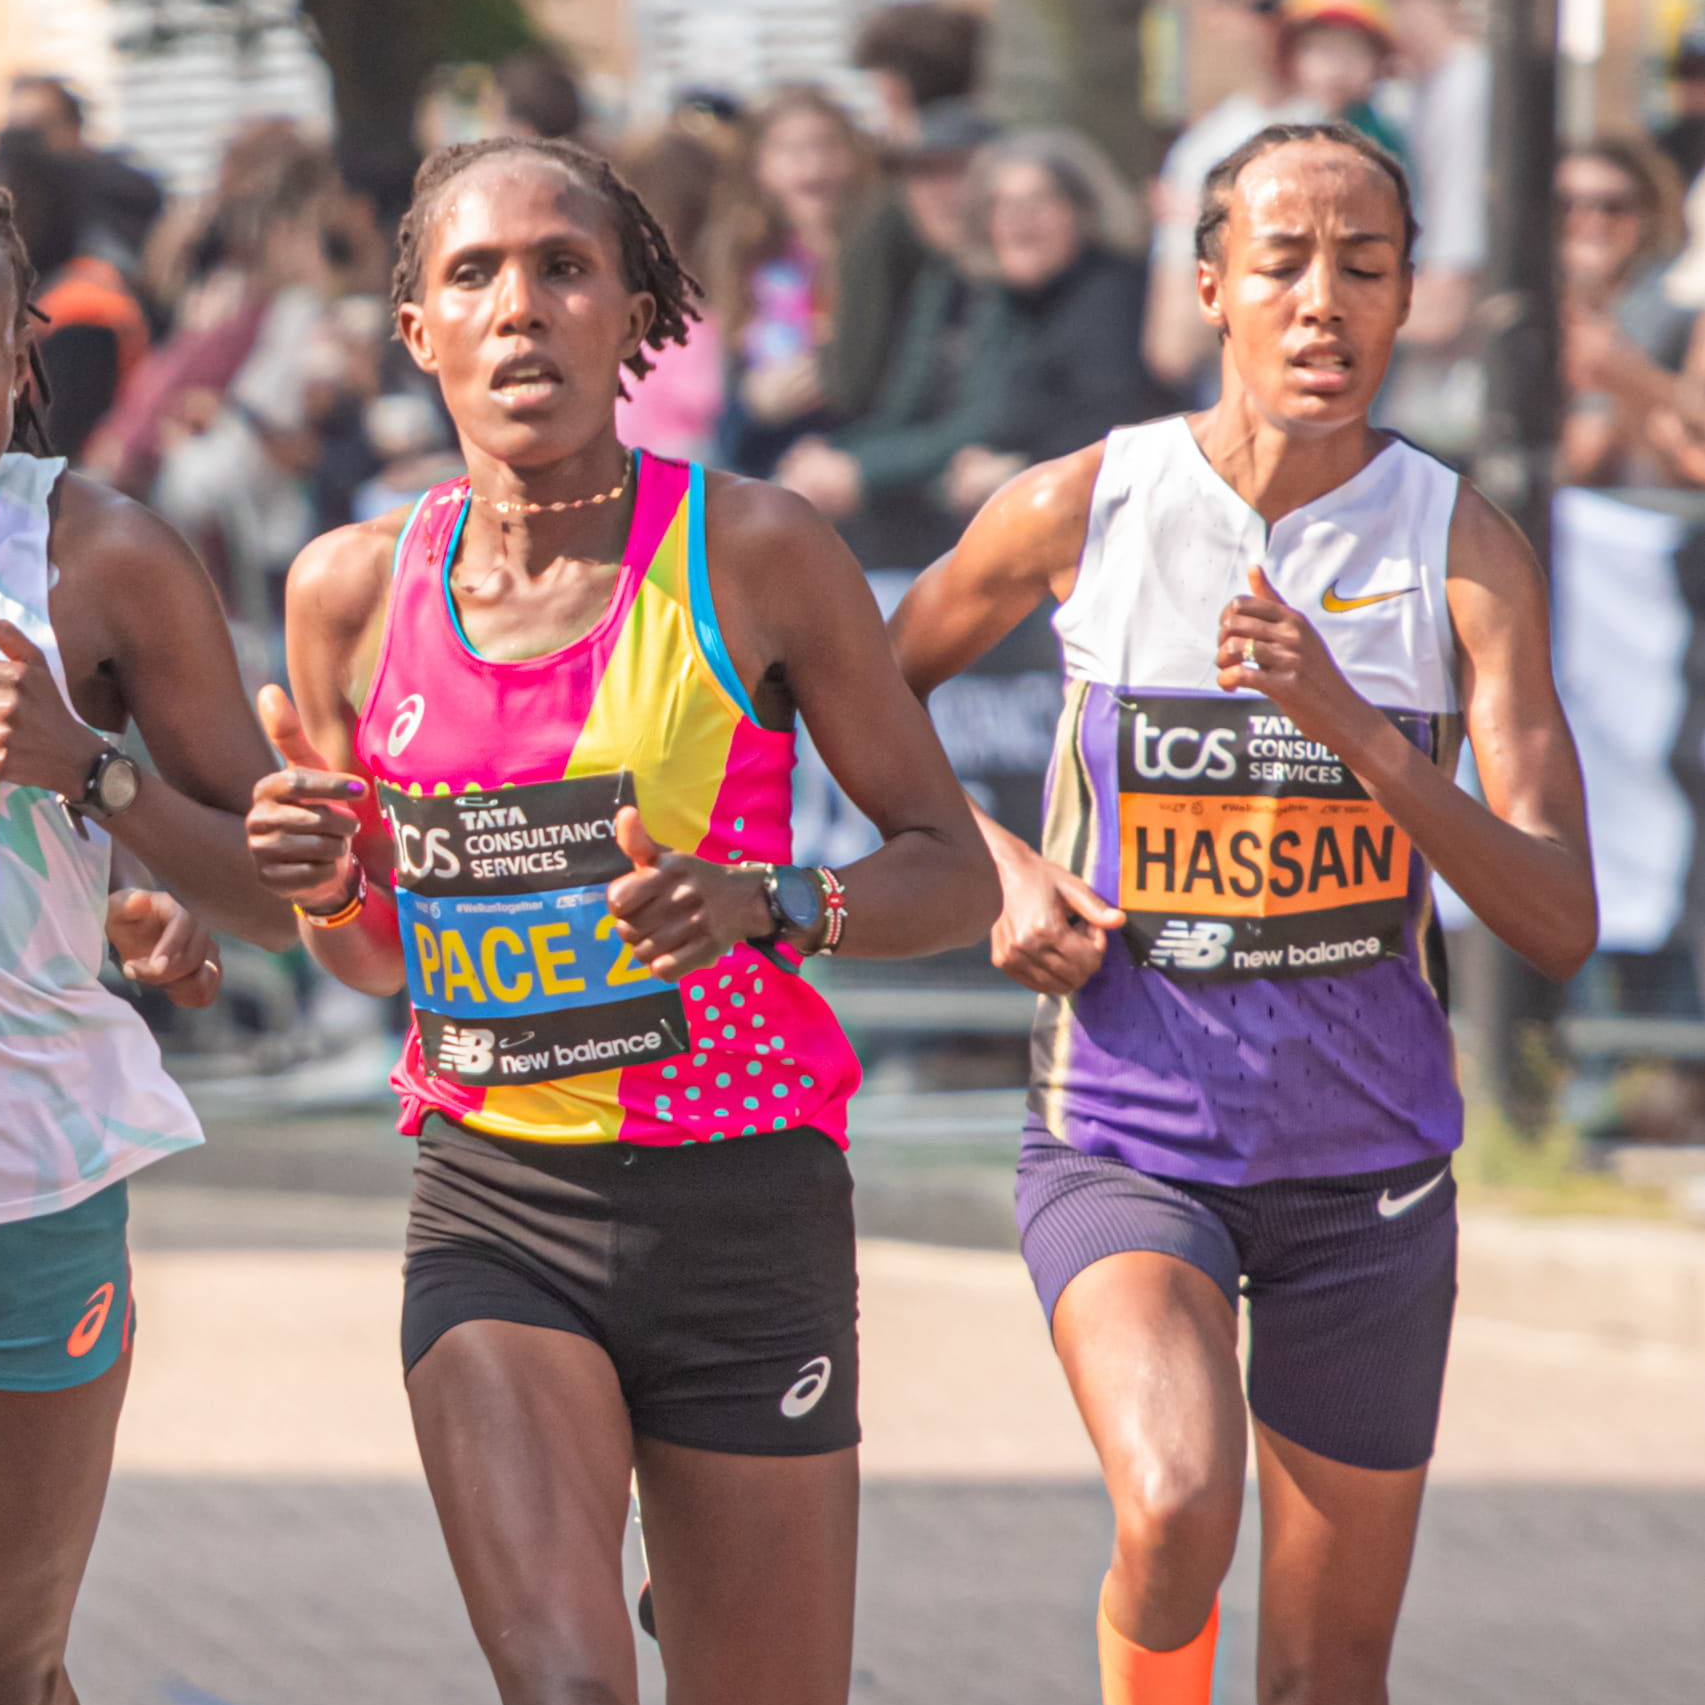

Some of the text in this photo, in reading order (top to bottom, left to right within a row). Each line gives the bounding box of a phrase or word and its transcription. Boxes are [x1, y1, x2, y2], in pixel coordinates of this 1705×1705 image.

[1248, 714, 1303, 736] TAT
[1134, 712, 1237, 780] tcs
[1247, 738, 1340, 763] CONSUL
[1248, 762, 1343, 785] SERVICES
[459, 806, 527, 831] TATA
[389, 804, 461, 878] tcs
[464, 818, 617, 855] CONSULTANCY
[470, 849, 567, 879] SERVICES
[1135, 825, 1395, 898] HASSAN
[413, 913, 652, 1003] PACE 2
[1233, 936, 1381, 969] new balance
[499, 1031, 661, 1074] new balance
